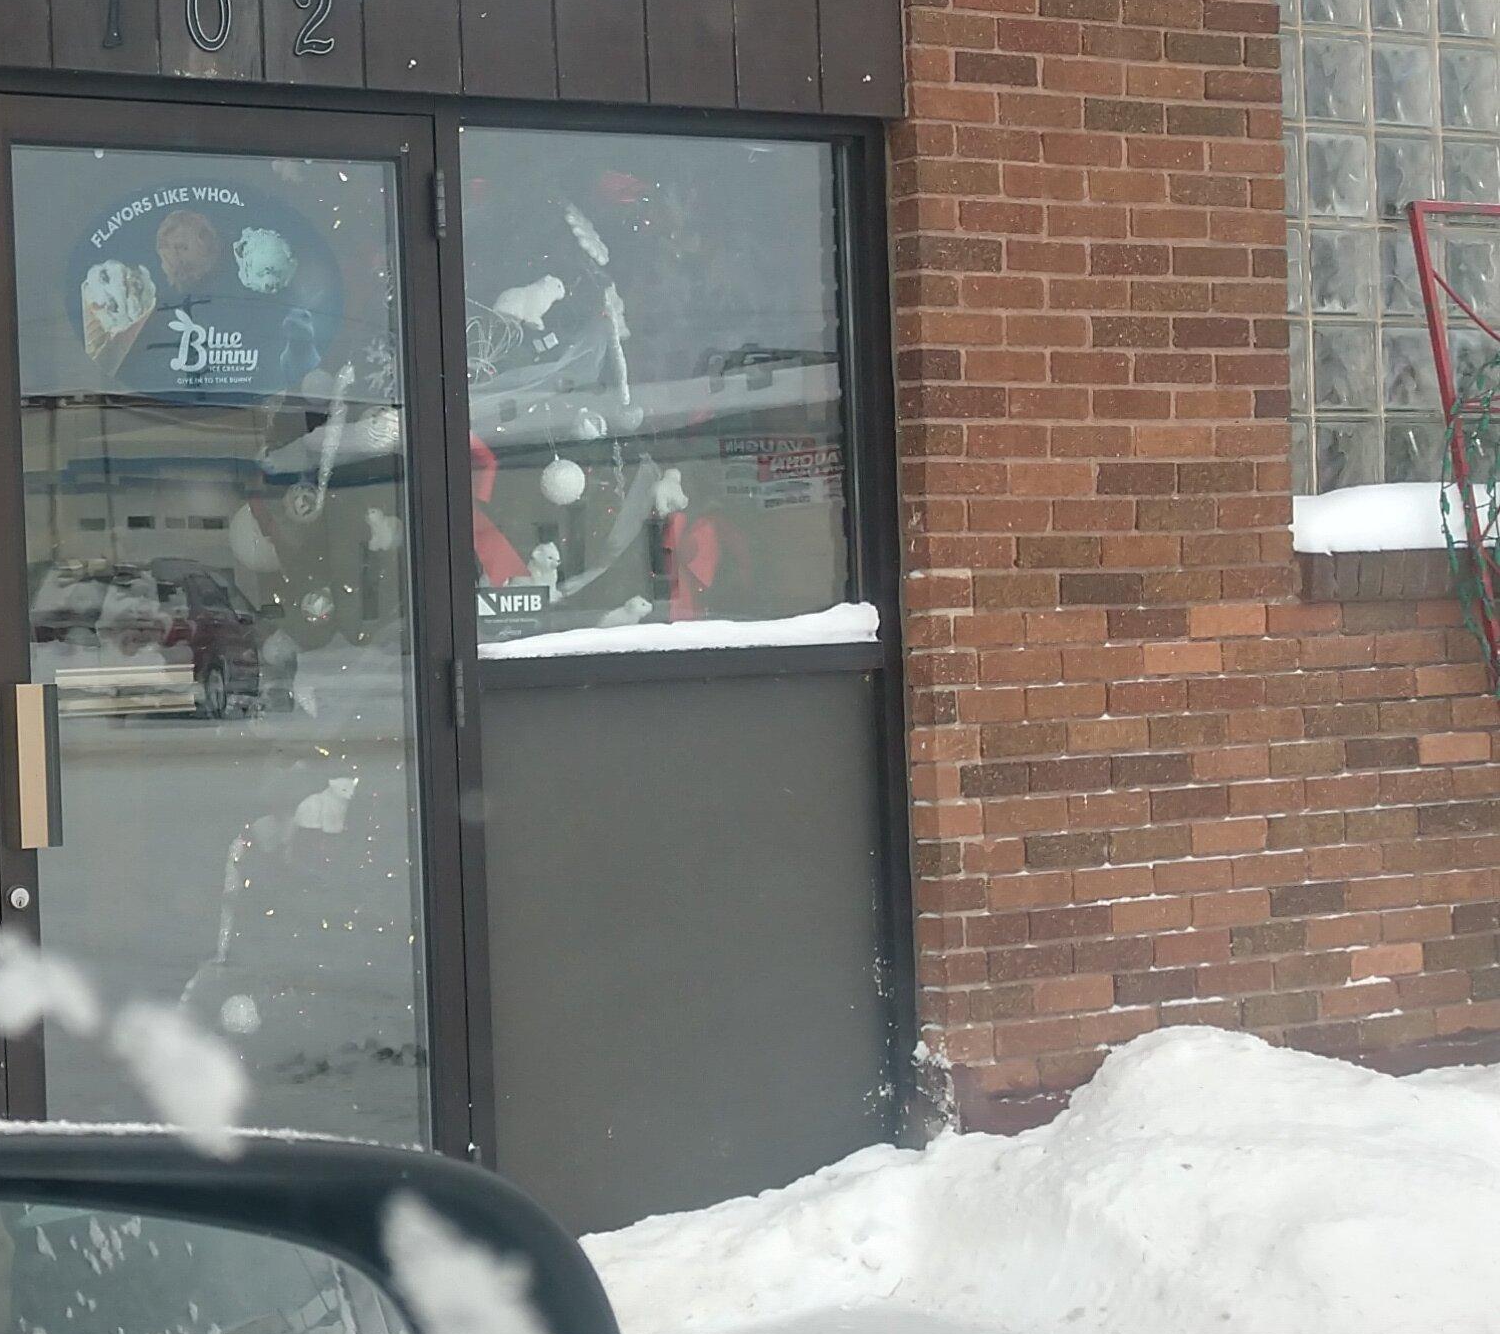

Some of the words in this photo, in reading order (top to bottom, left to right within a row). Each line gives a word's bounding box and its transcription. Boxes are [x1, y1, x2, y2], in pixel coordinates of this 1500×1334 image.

[90, 197, 153, 248] FLAVORS
[153, 188, 190, 207] LIKE
[192, 187, 245, 207] WHOA.
[169, 309, 243, 369] Blue
[214, 376, 228, 384] THE
[500, 594, 542, 613] NFIB
